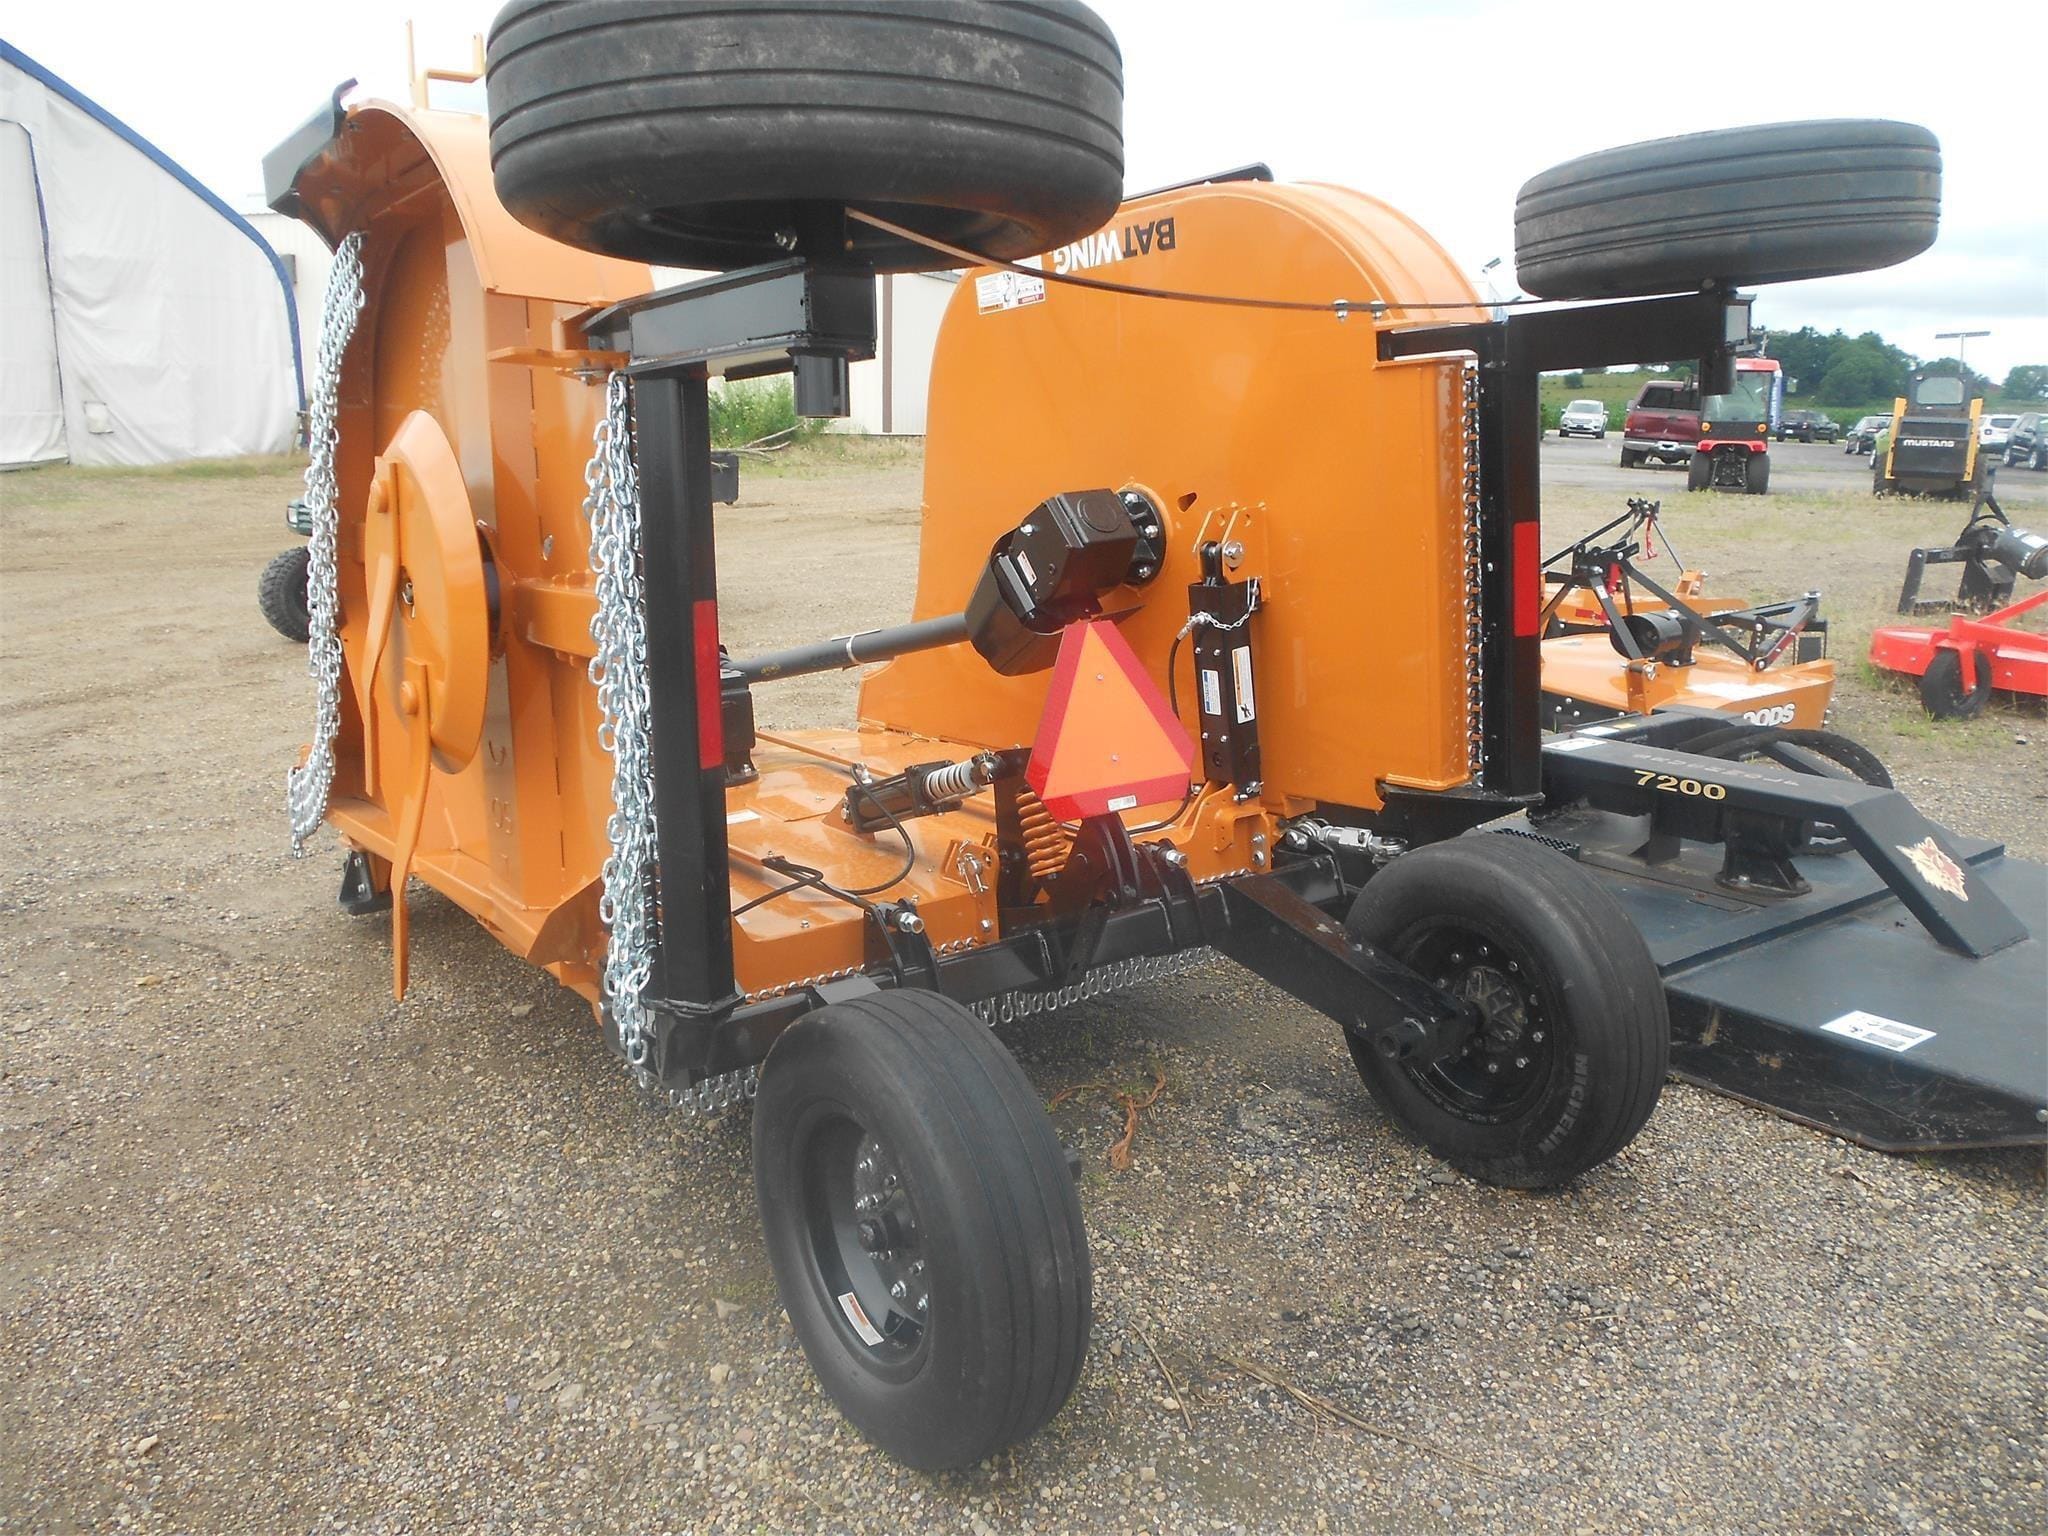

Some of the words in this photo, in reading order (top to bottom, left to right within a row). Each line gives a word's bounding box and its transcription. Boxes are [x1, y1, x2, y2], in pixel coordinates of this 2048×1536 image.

[1053, 217, 1176, 275] BATWING
[1903, 439, 1955, 448] MUSTANG
[1743, 702, 1796, 727] OODS
[1634, 769, 1726, 801] 7200
[1538, 1053, 1589, 1154] MICHELIN
